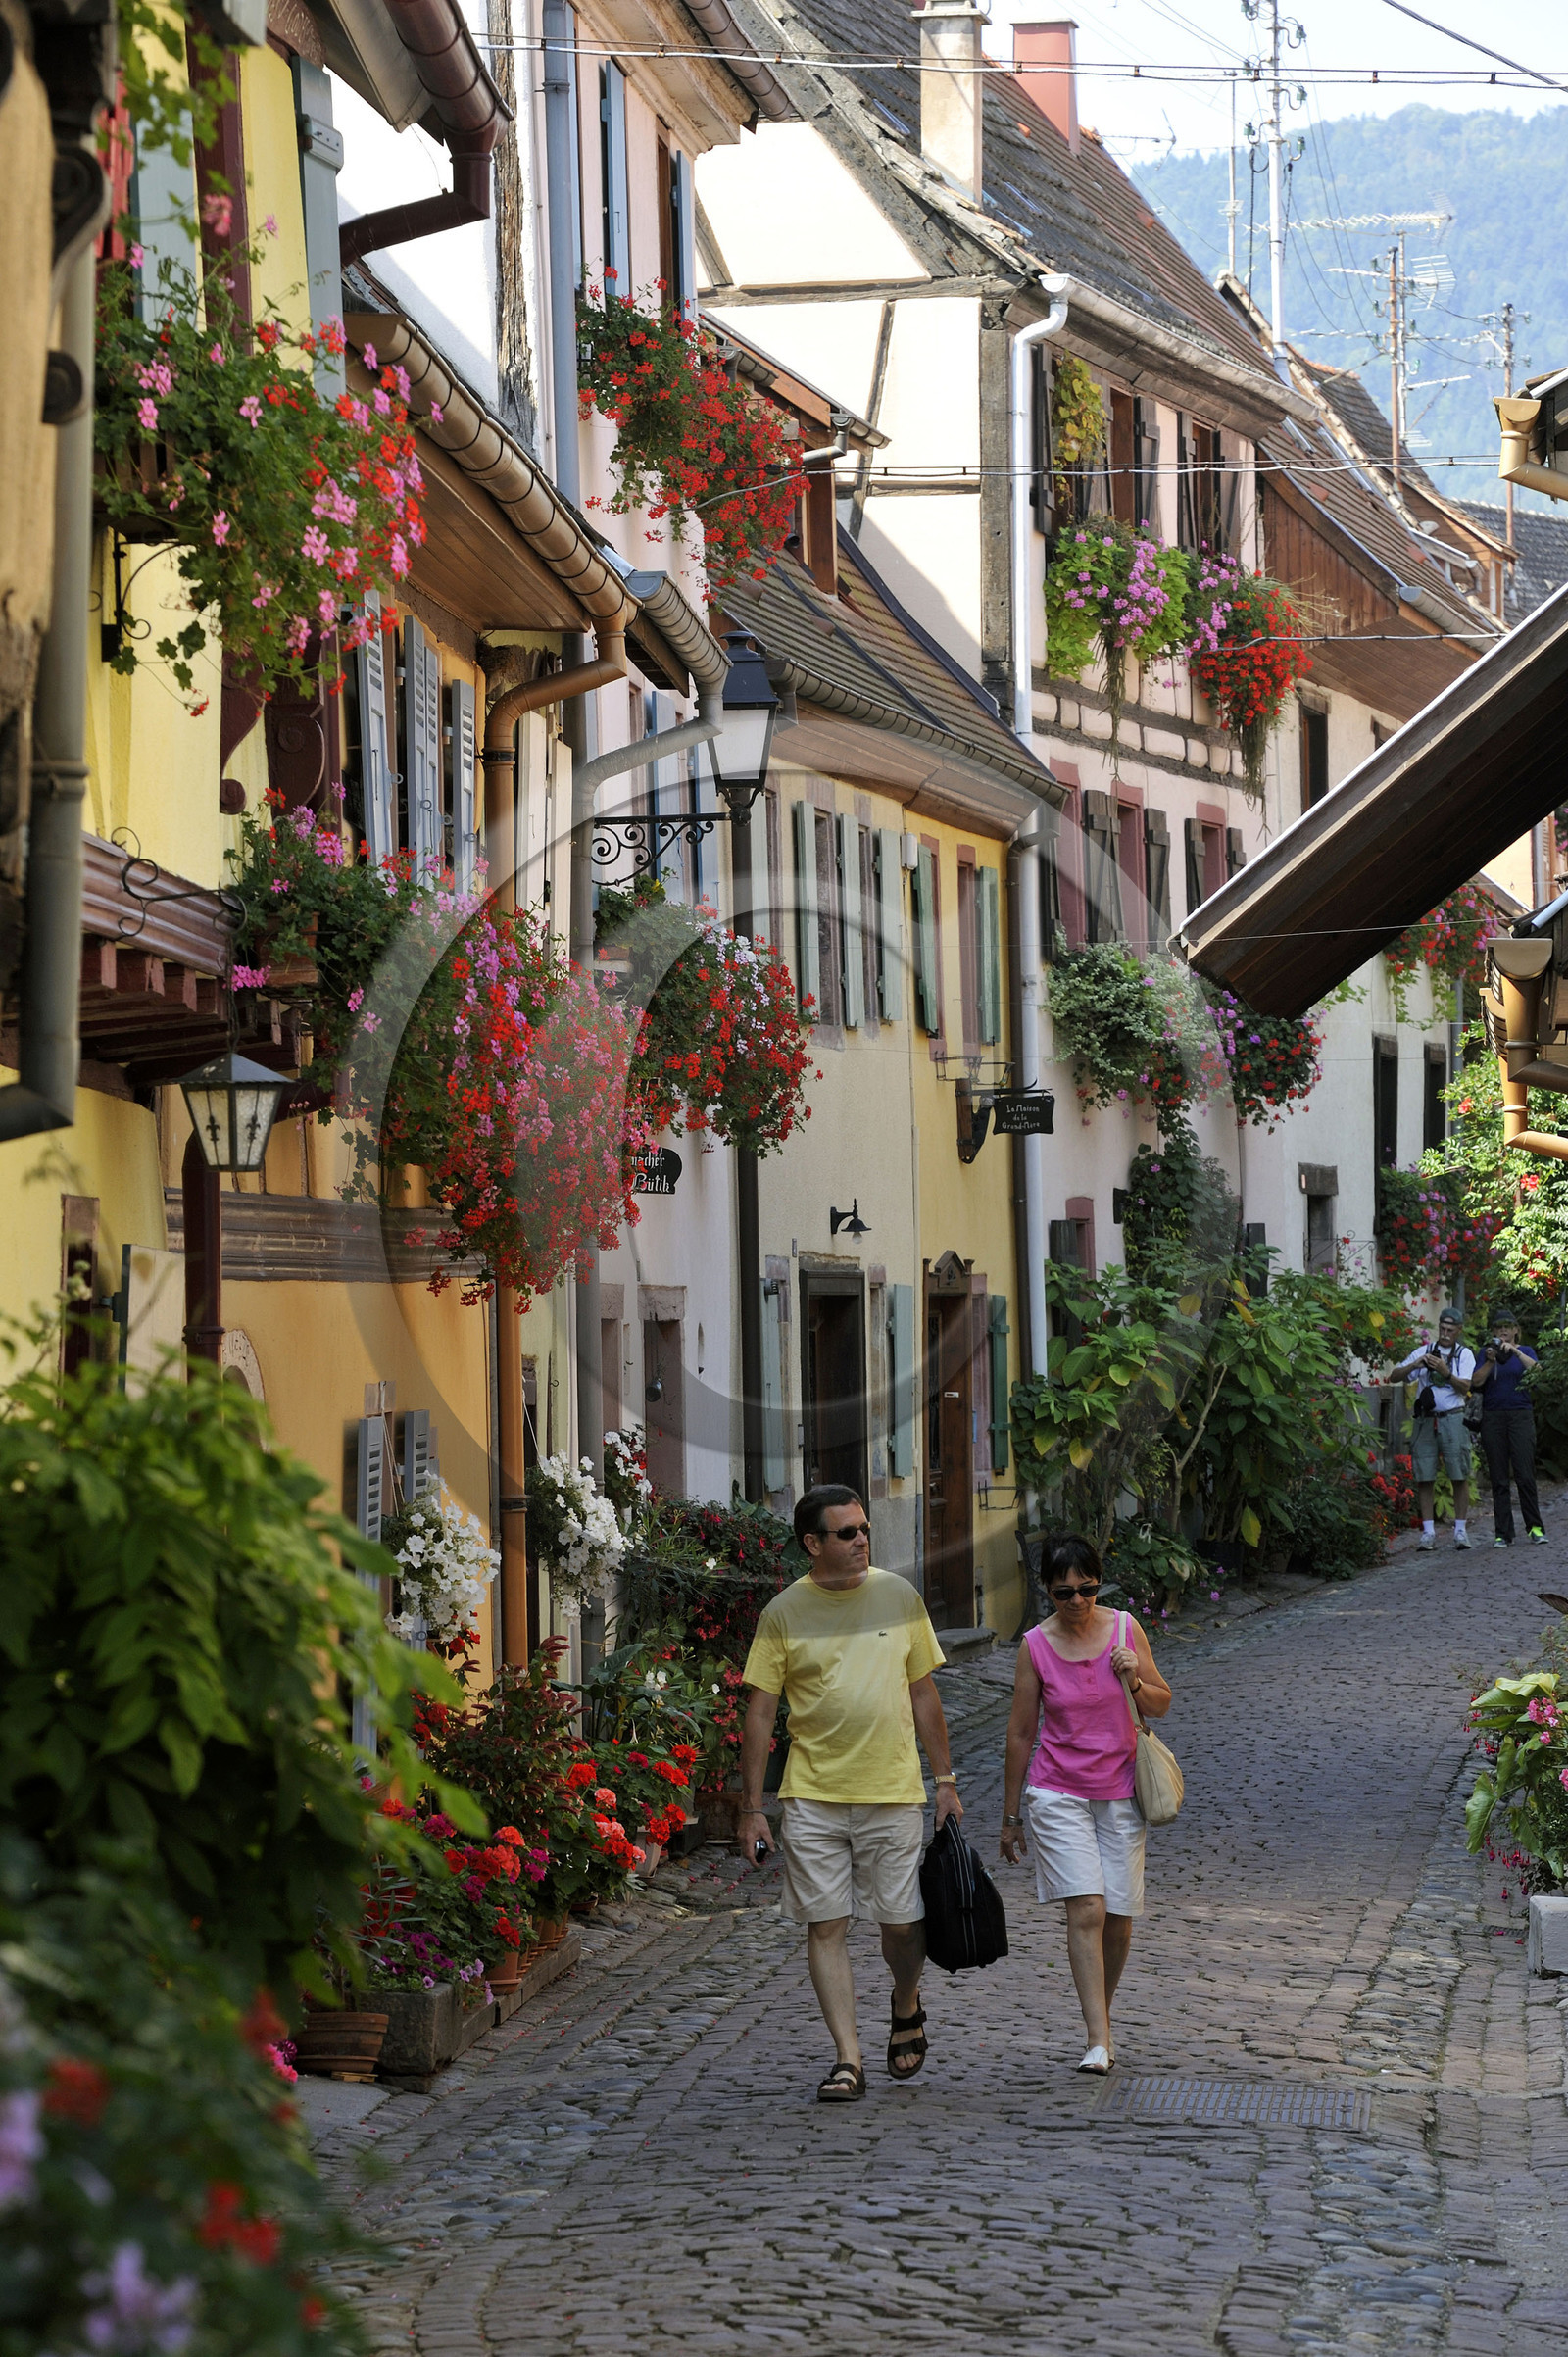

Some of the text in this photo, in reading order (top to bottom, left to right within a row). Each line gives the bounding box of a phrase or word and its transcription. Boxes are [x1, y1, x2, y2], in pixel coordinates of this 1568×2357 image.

[1006, 1105, 1040, 1113] La Maison
[630, 1172, 670, 1193] Bütik
